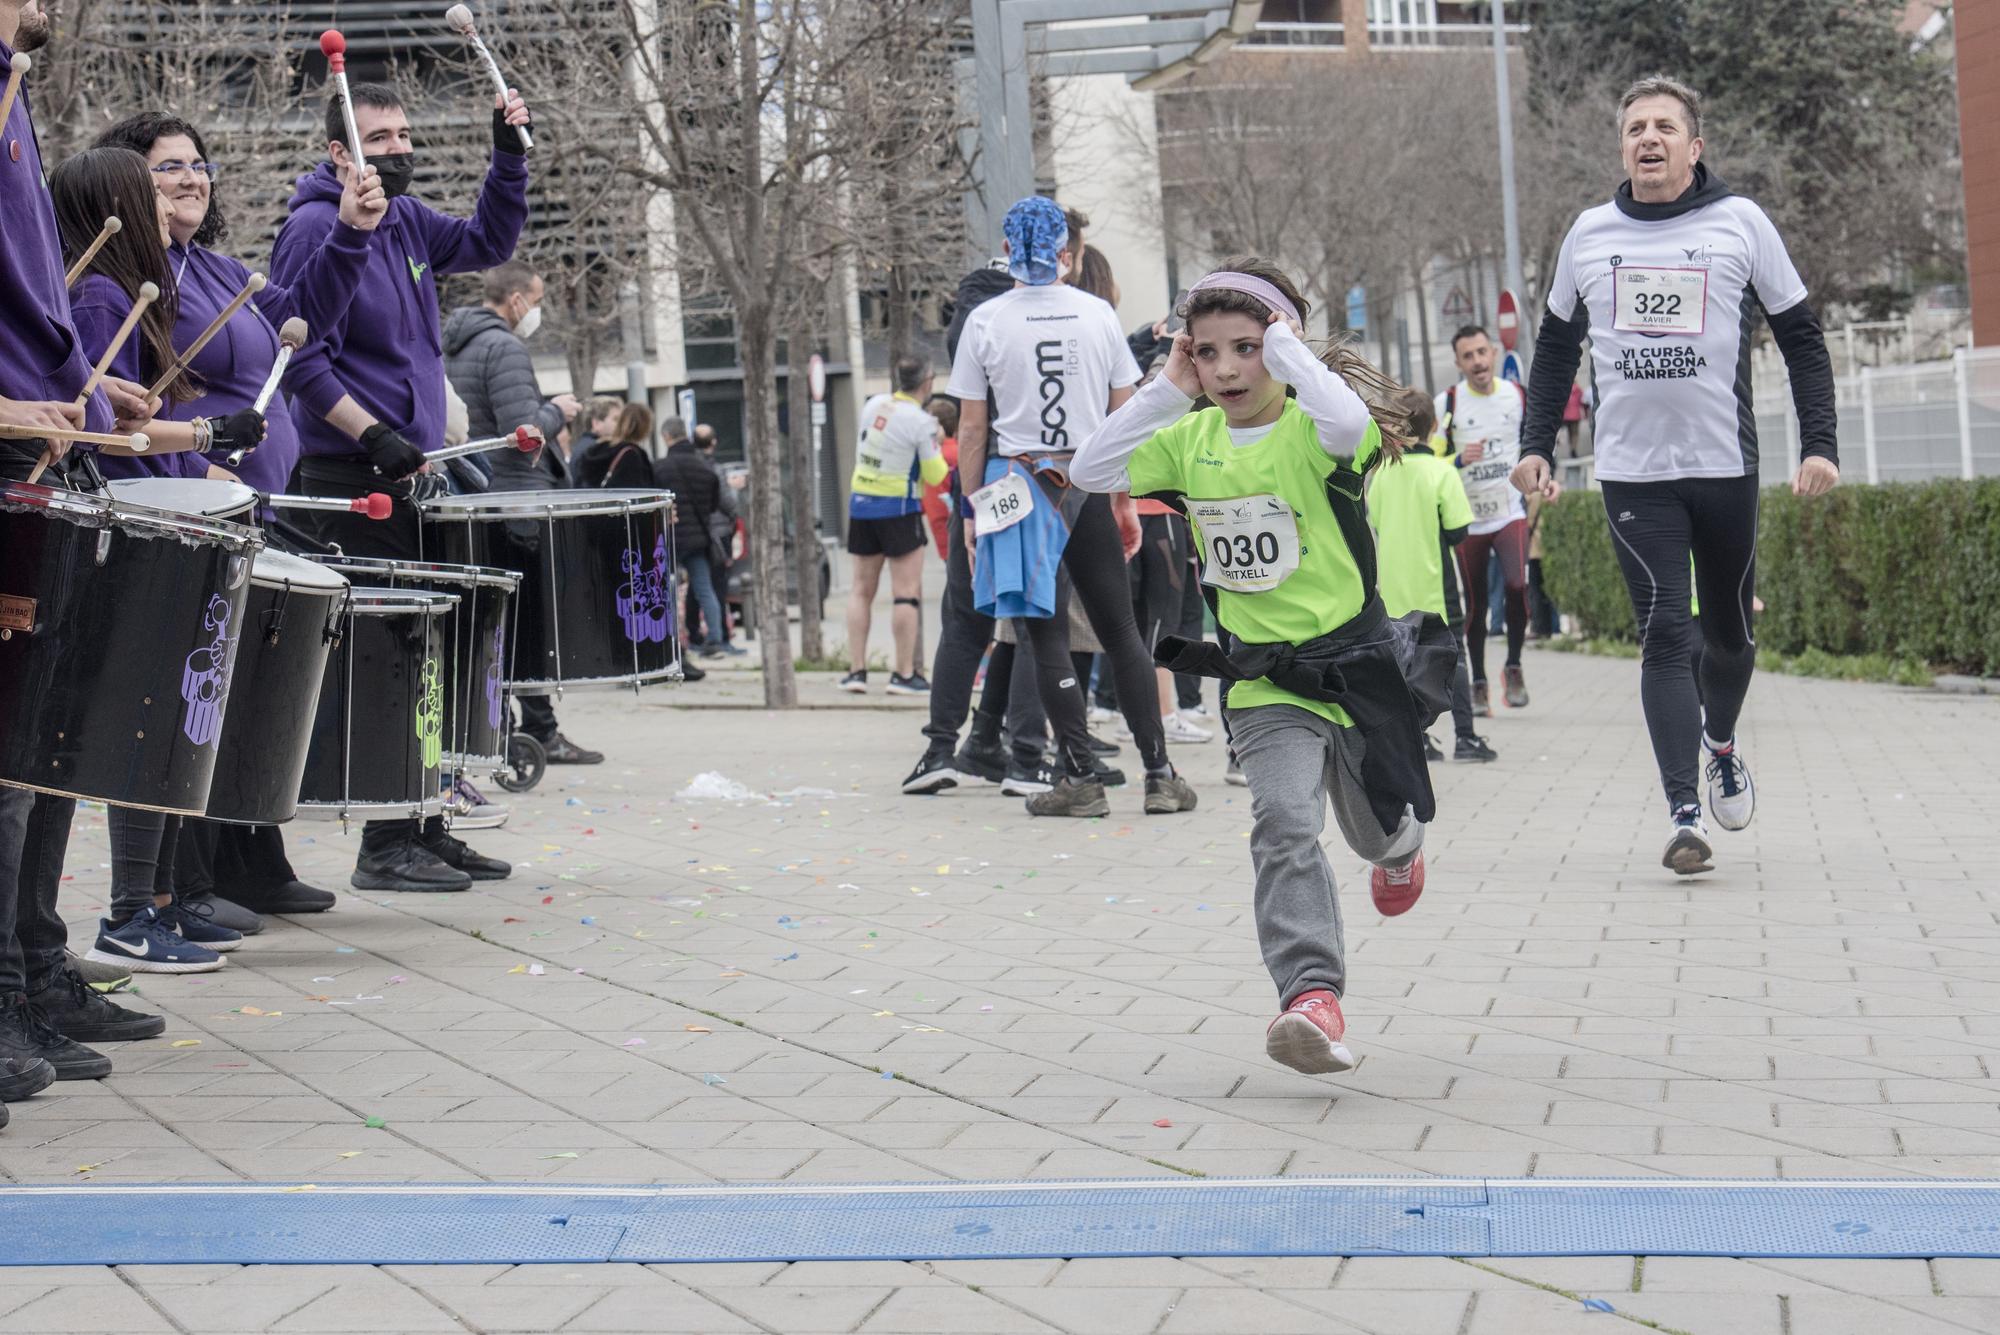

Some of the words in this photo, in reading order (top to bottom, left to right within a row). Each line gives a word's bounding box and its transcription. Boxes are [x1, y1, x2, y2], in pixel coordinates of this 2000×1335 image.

[1635, 293, 1681, 315] 322
[1642, 316, 1672, 324] XAVIER
[1065, 339, 1079, 376] fibra
[1621, 348, 1635, 360] VI
[1640, 346, 1696, 359] CURSA
[1614, 360, 1631, 371] DE
[1635, 359, 1655, 370] LA
[1659, 356, 1707, 369] DONA
[1623, 367, 1698, 381] MANRESA
[990, 493, 1019, 519] 188
[1213, 531, 1279, 568] 030
